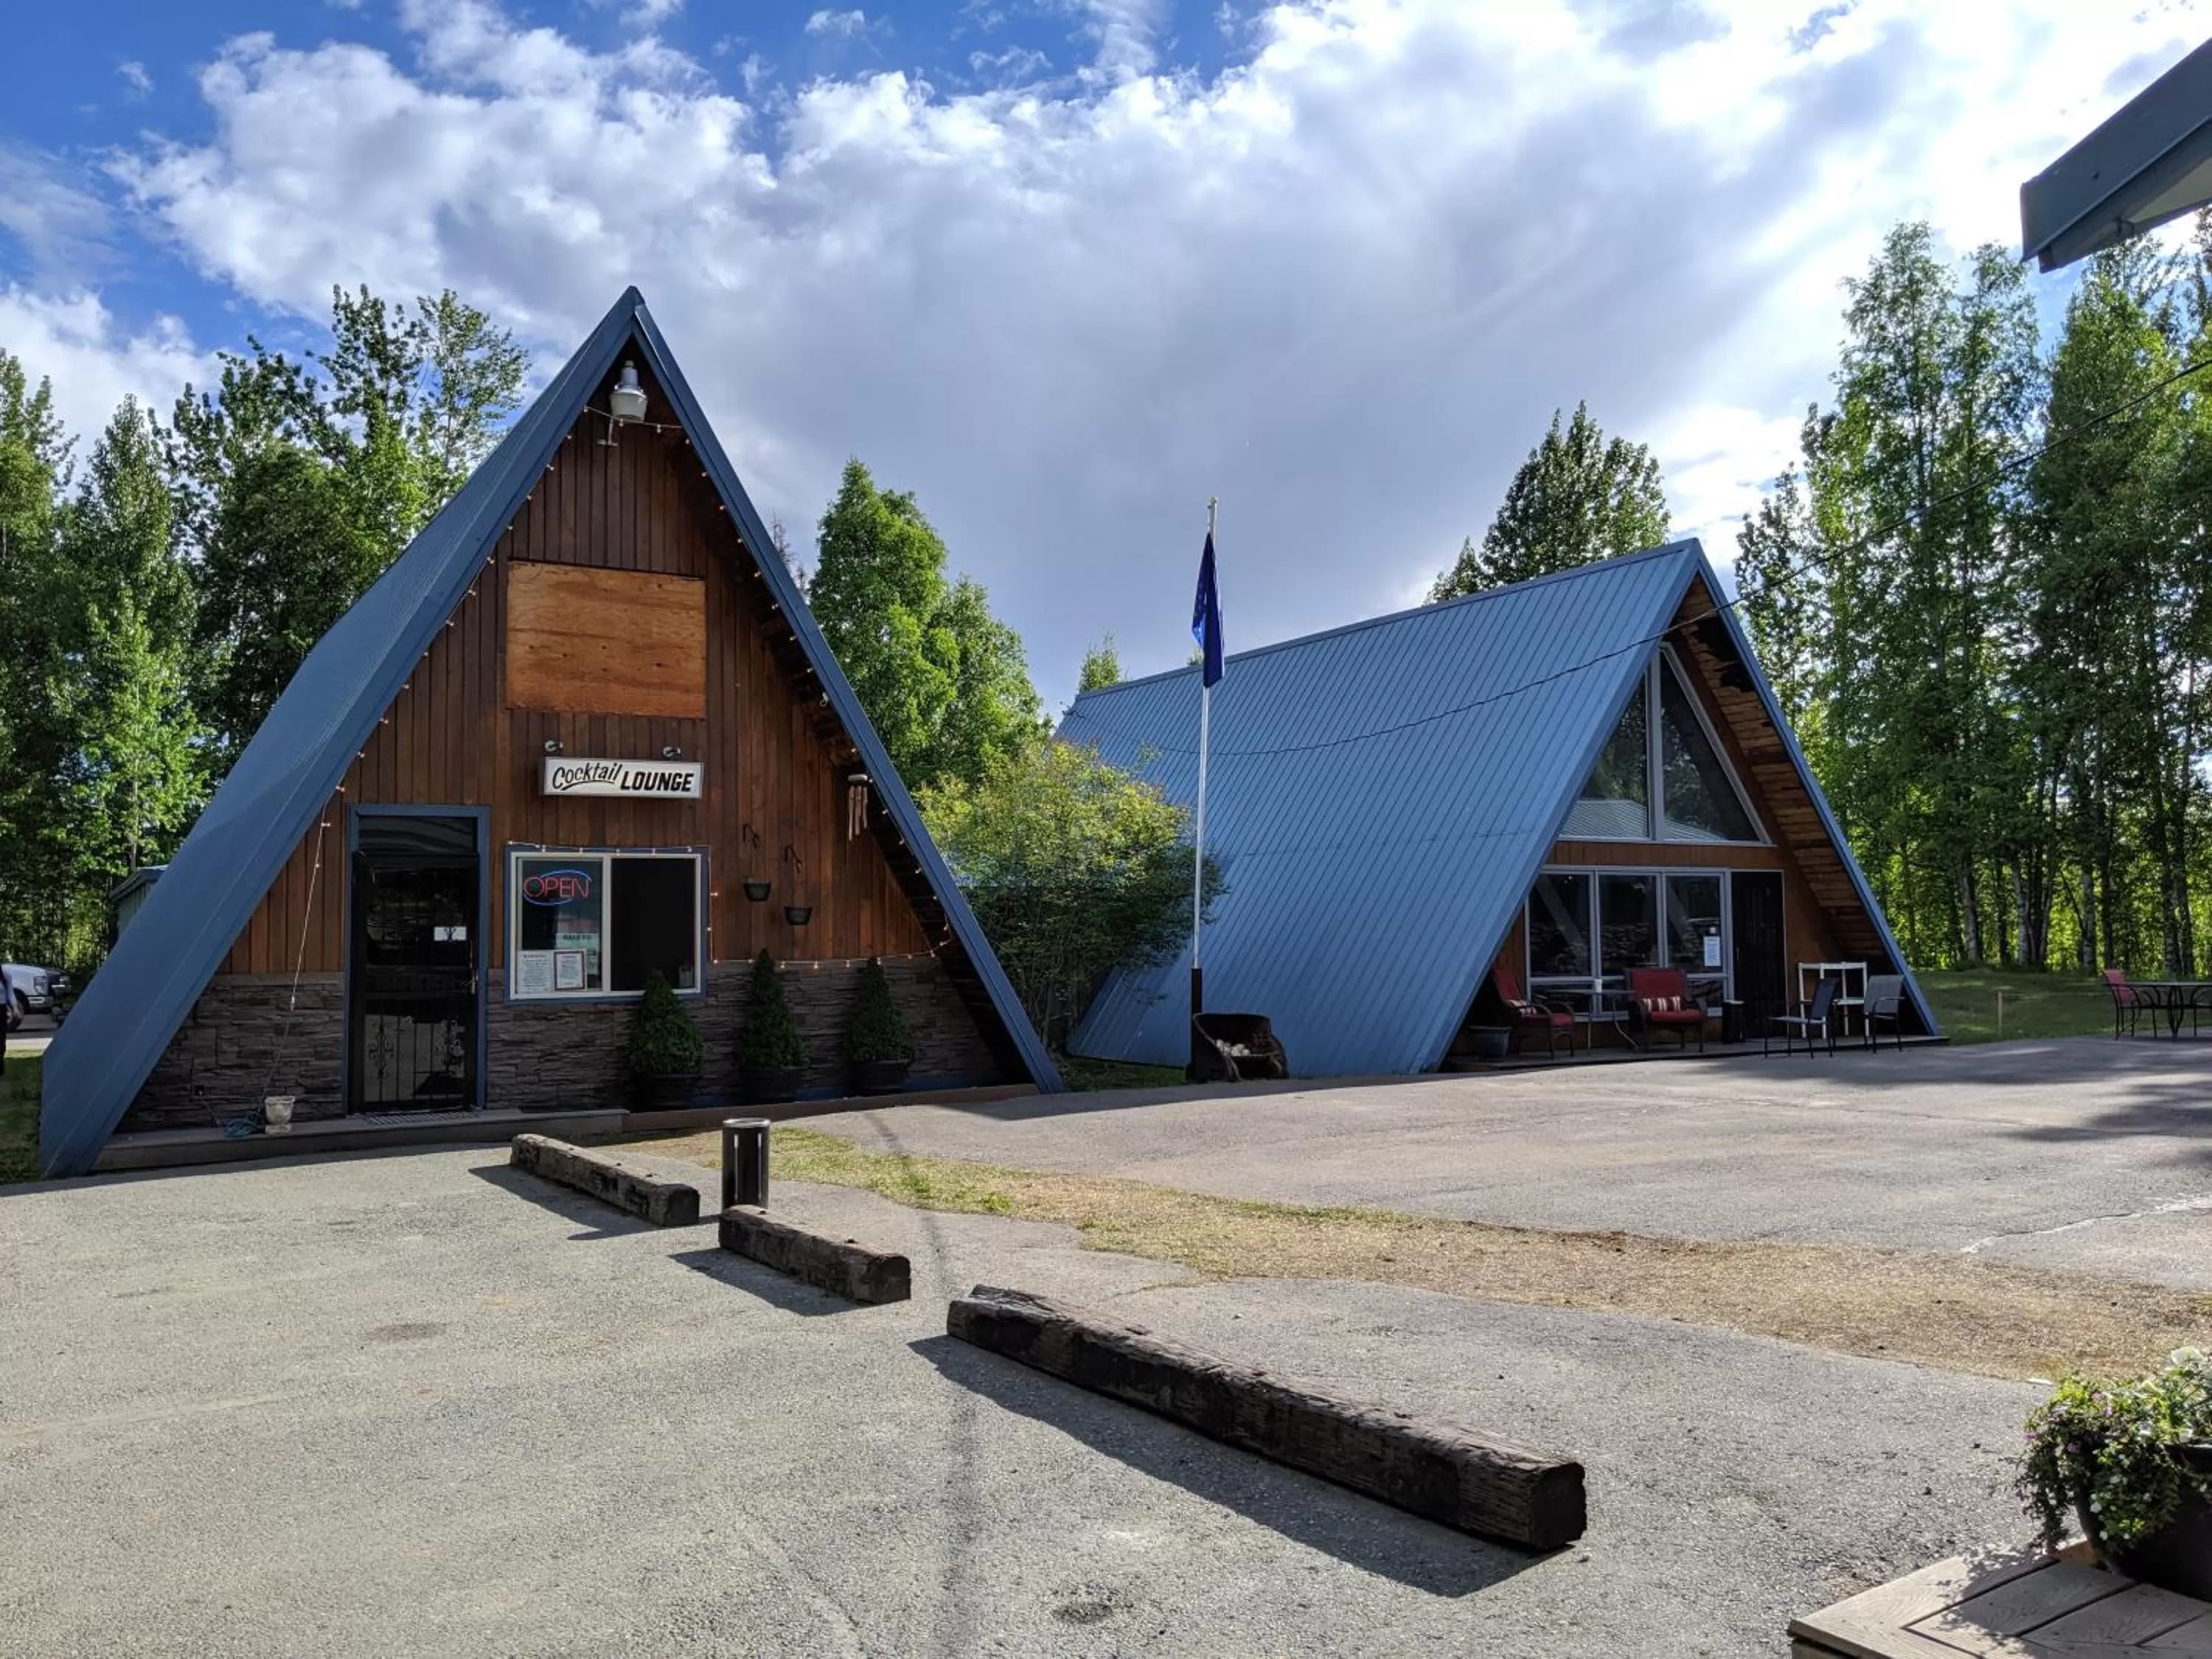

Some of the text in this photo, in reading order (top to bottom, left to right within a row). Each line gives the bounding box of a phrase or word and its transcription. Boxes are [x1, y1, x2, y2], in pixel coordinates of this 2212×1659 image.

[553, 762, 694, 792] Cocktail LOUNGE
[524, 876, 589, 897] OPEN
